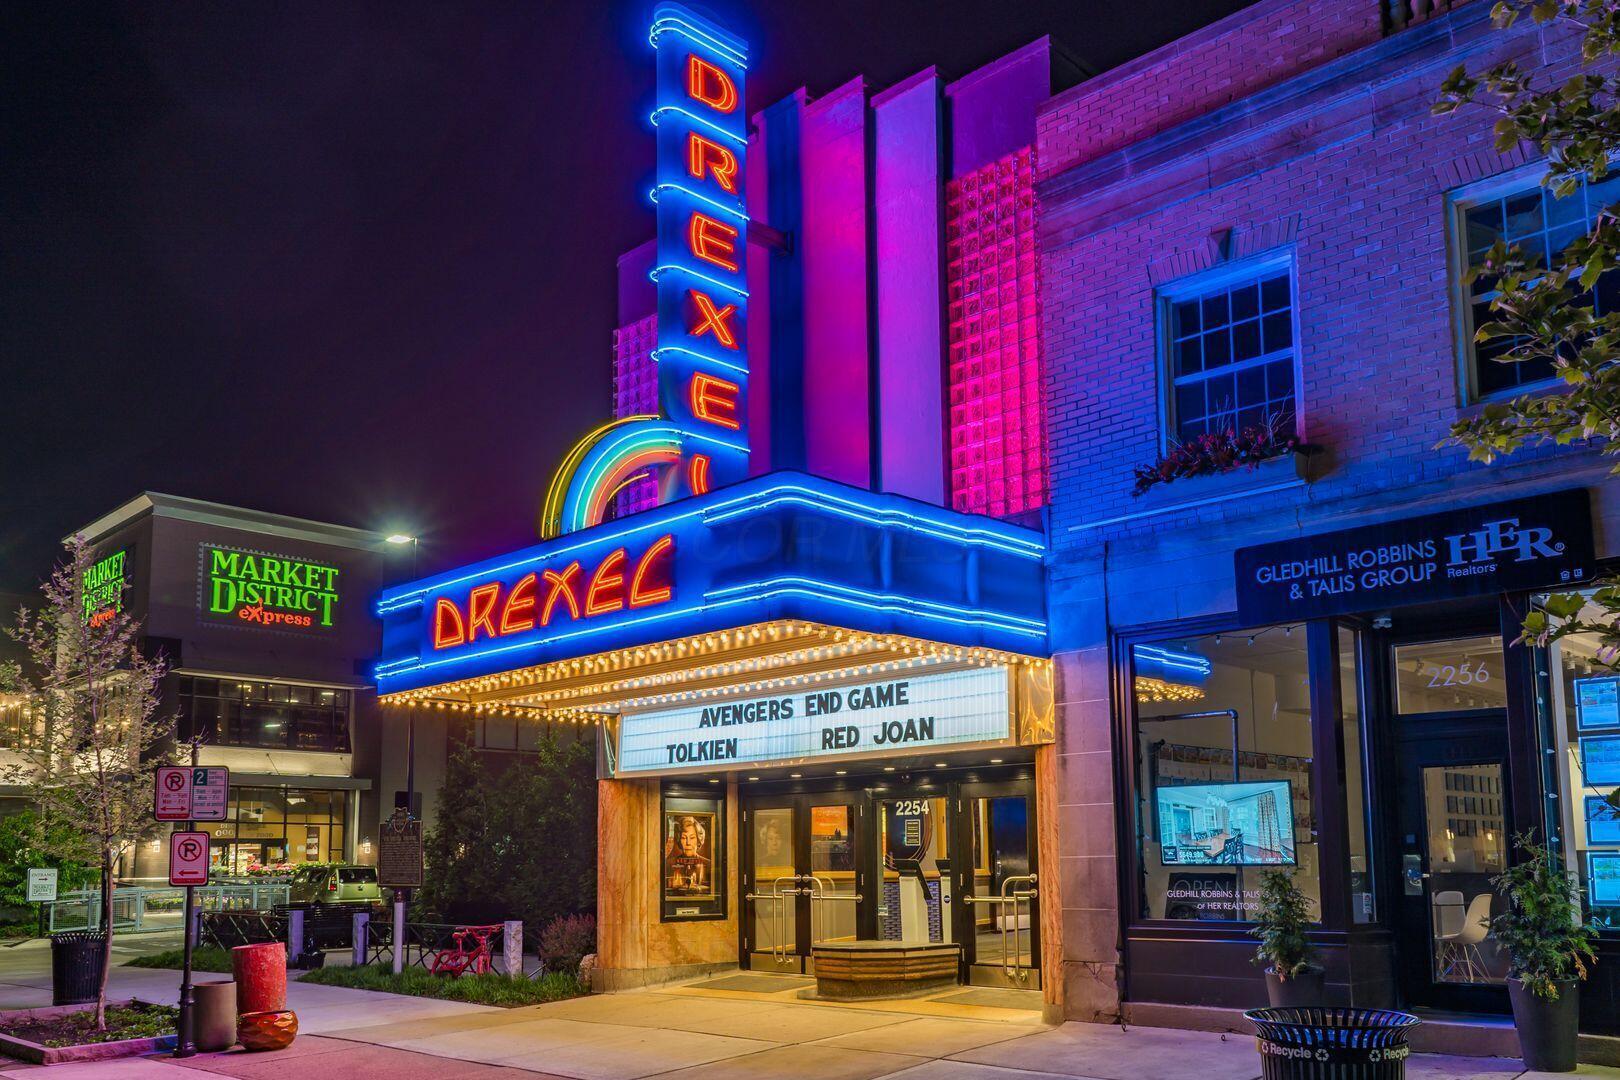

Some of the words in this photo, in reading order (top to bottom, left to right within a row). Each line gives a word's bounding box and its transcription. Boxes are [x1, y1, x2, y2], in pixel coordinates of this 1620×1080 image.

[83, 550, 126, 589] MARKET
[211, 550, 339, 591] MARKET
[1256, 556, 1343, 585] GLEDHILL
[1348, 540, 1436, 569] ROBBINS
[1289, 583, 1303, 600] &
[1308, 575, 1355, 597] TALIS
[1362, 563, 1437, 589] GROUP
[82, 577, 124, 625] DISRICT
[210, 577, 338, 626] DISTRICT
[434, 534, 672, 649] DREXEL
[1427, 661, 1490, 688] 2256
[699, 698, 794, 728] AVENGERS
[805, 692, 842, 717] END
[847, 682, 909, 709] GAME
[666, 738, 738, 764] TOLKIEN
[821, 725, 860, 750] RED
[873, 717, 934, 745] JOAN
[196, 771, 205, 785] 2
[896, 800, 930, 816] 2254
[1167, 890, 1199, 898] GLEDHILL
[1201, 890, 1233, 898] ROBBINS
[1207, 902, 1222, 910] HER
[1223, 902, 1260, 910] REALTORS
[1270, 1044, 1312, 1059] Recycle
